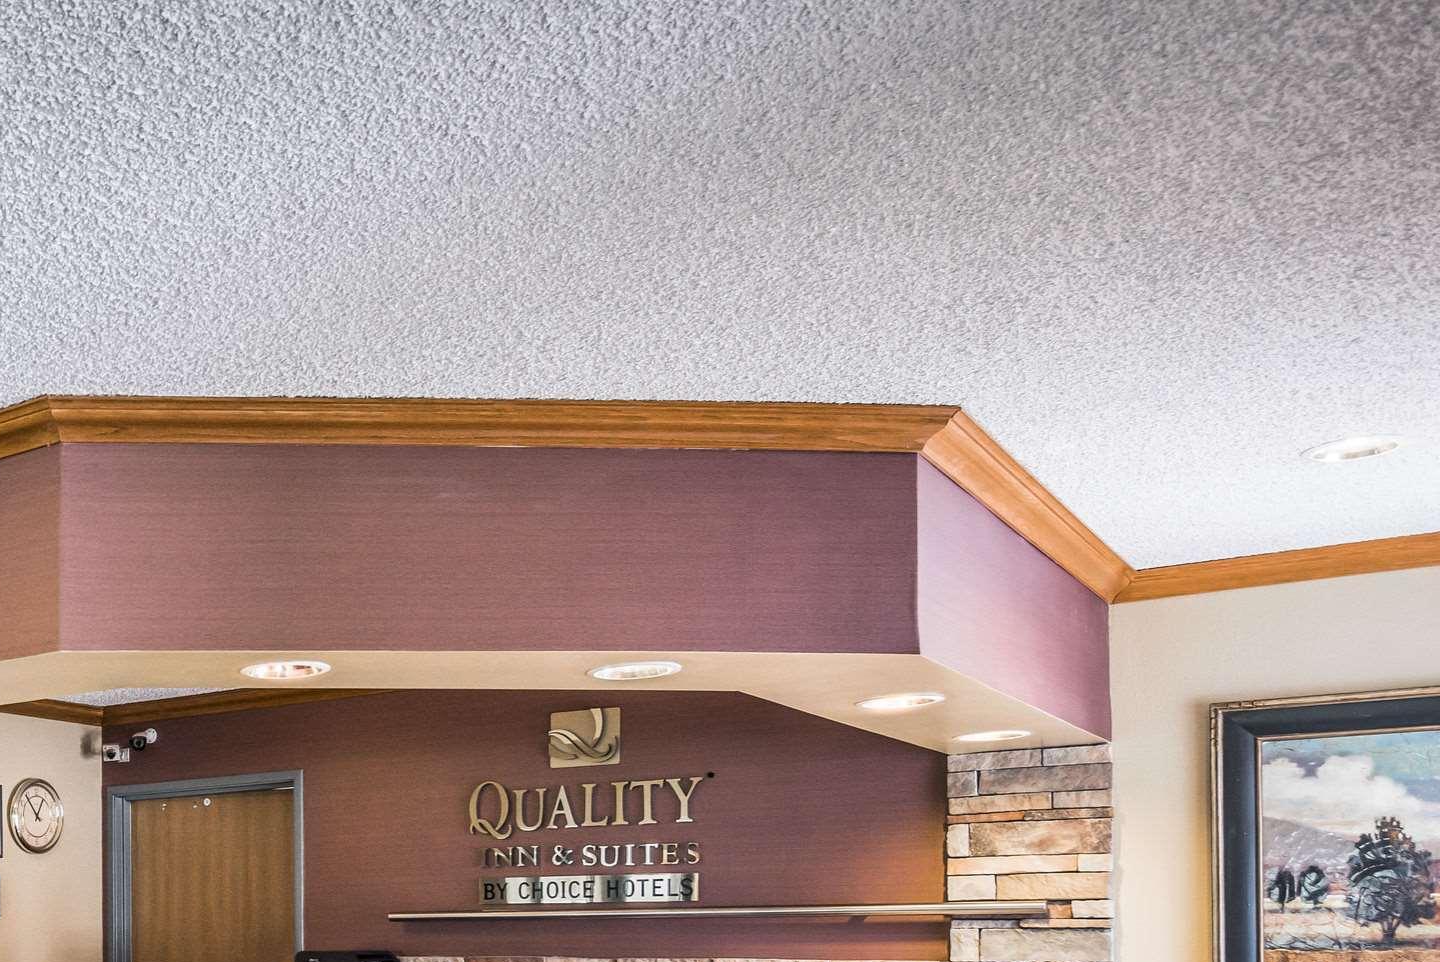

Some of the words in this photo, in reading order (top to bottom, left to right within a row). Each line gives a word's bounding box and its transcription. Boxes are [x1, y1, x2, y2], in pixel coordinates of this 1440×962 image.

[468, 776, 703, 840] QUALITY
[482, 845, 540, 868] INN
[551, 844, 574, 866] &
[582, 842, 700, 867] SUITES
[483, 882, 508, 900] BY
[518, 880, 595, 899] CHOICE
[607, 877, 694, 898] HOTELS
